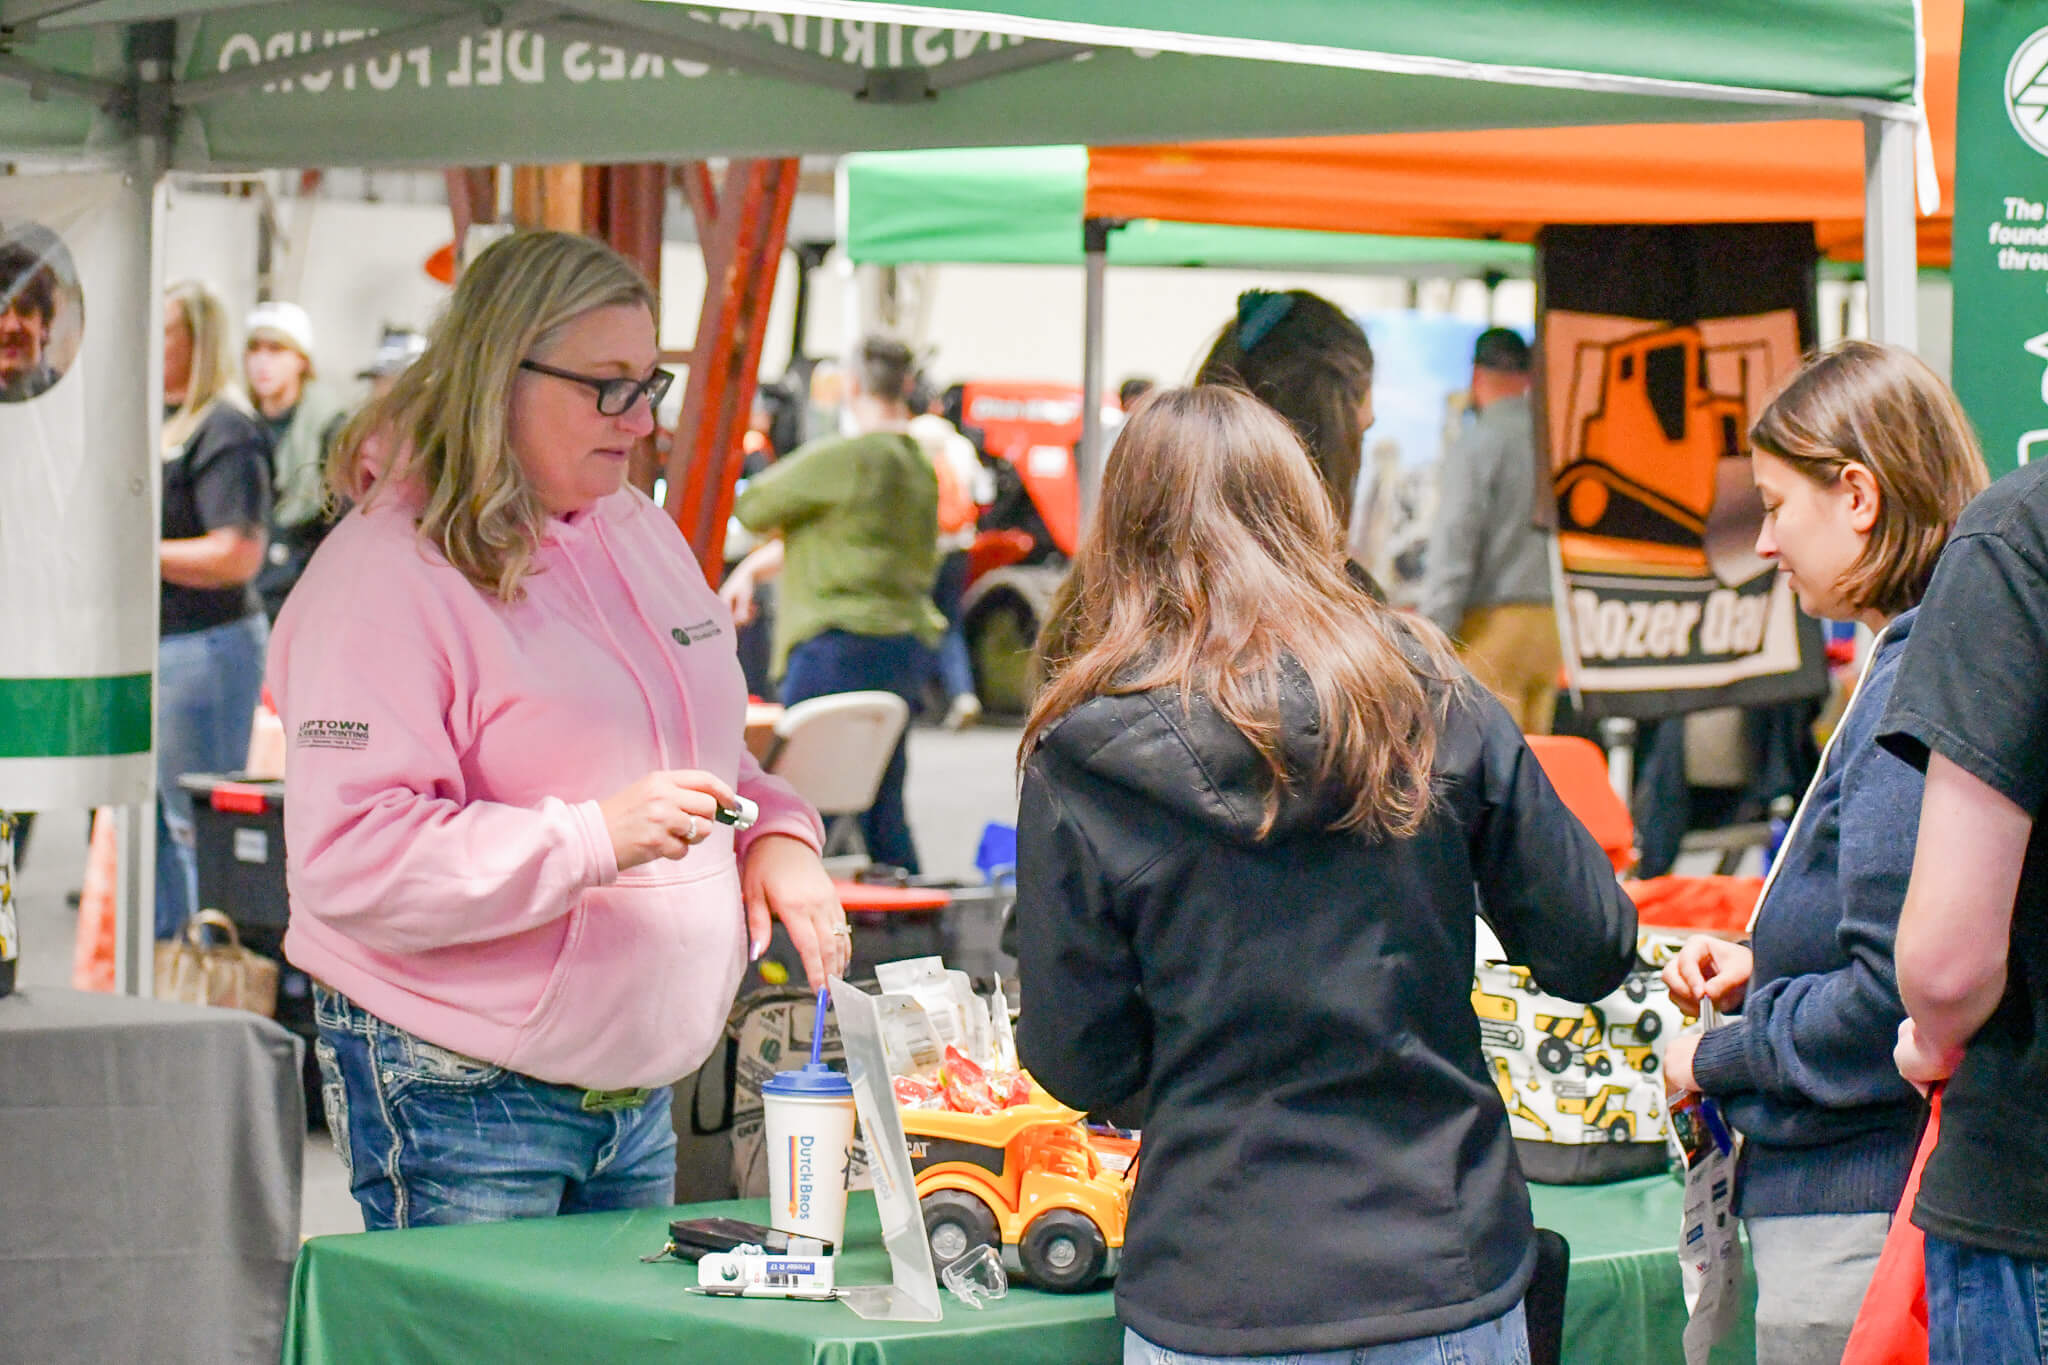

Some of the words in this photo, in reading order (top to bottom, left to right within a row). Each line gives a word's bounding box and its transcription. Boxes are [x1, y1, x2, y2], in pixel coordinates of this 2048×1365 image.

[2003, 197, 2045, 220] The
[1573, 589, 1700, 659] Dozer
[906, 1142, 931, 1158] CAT
